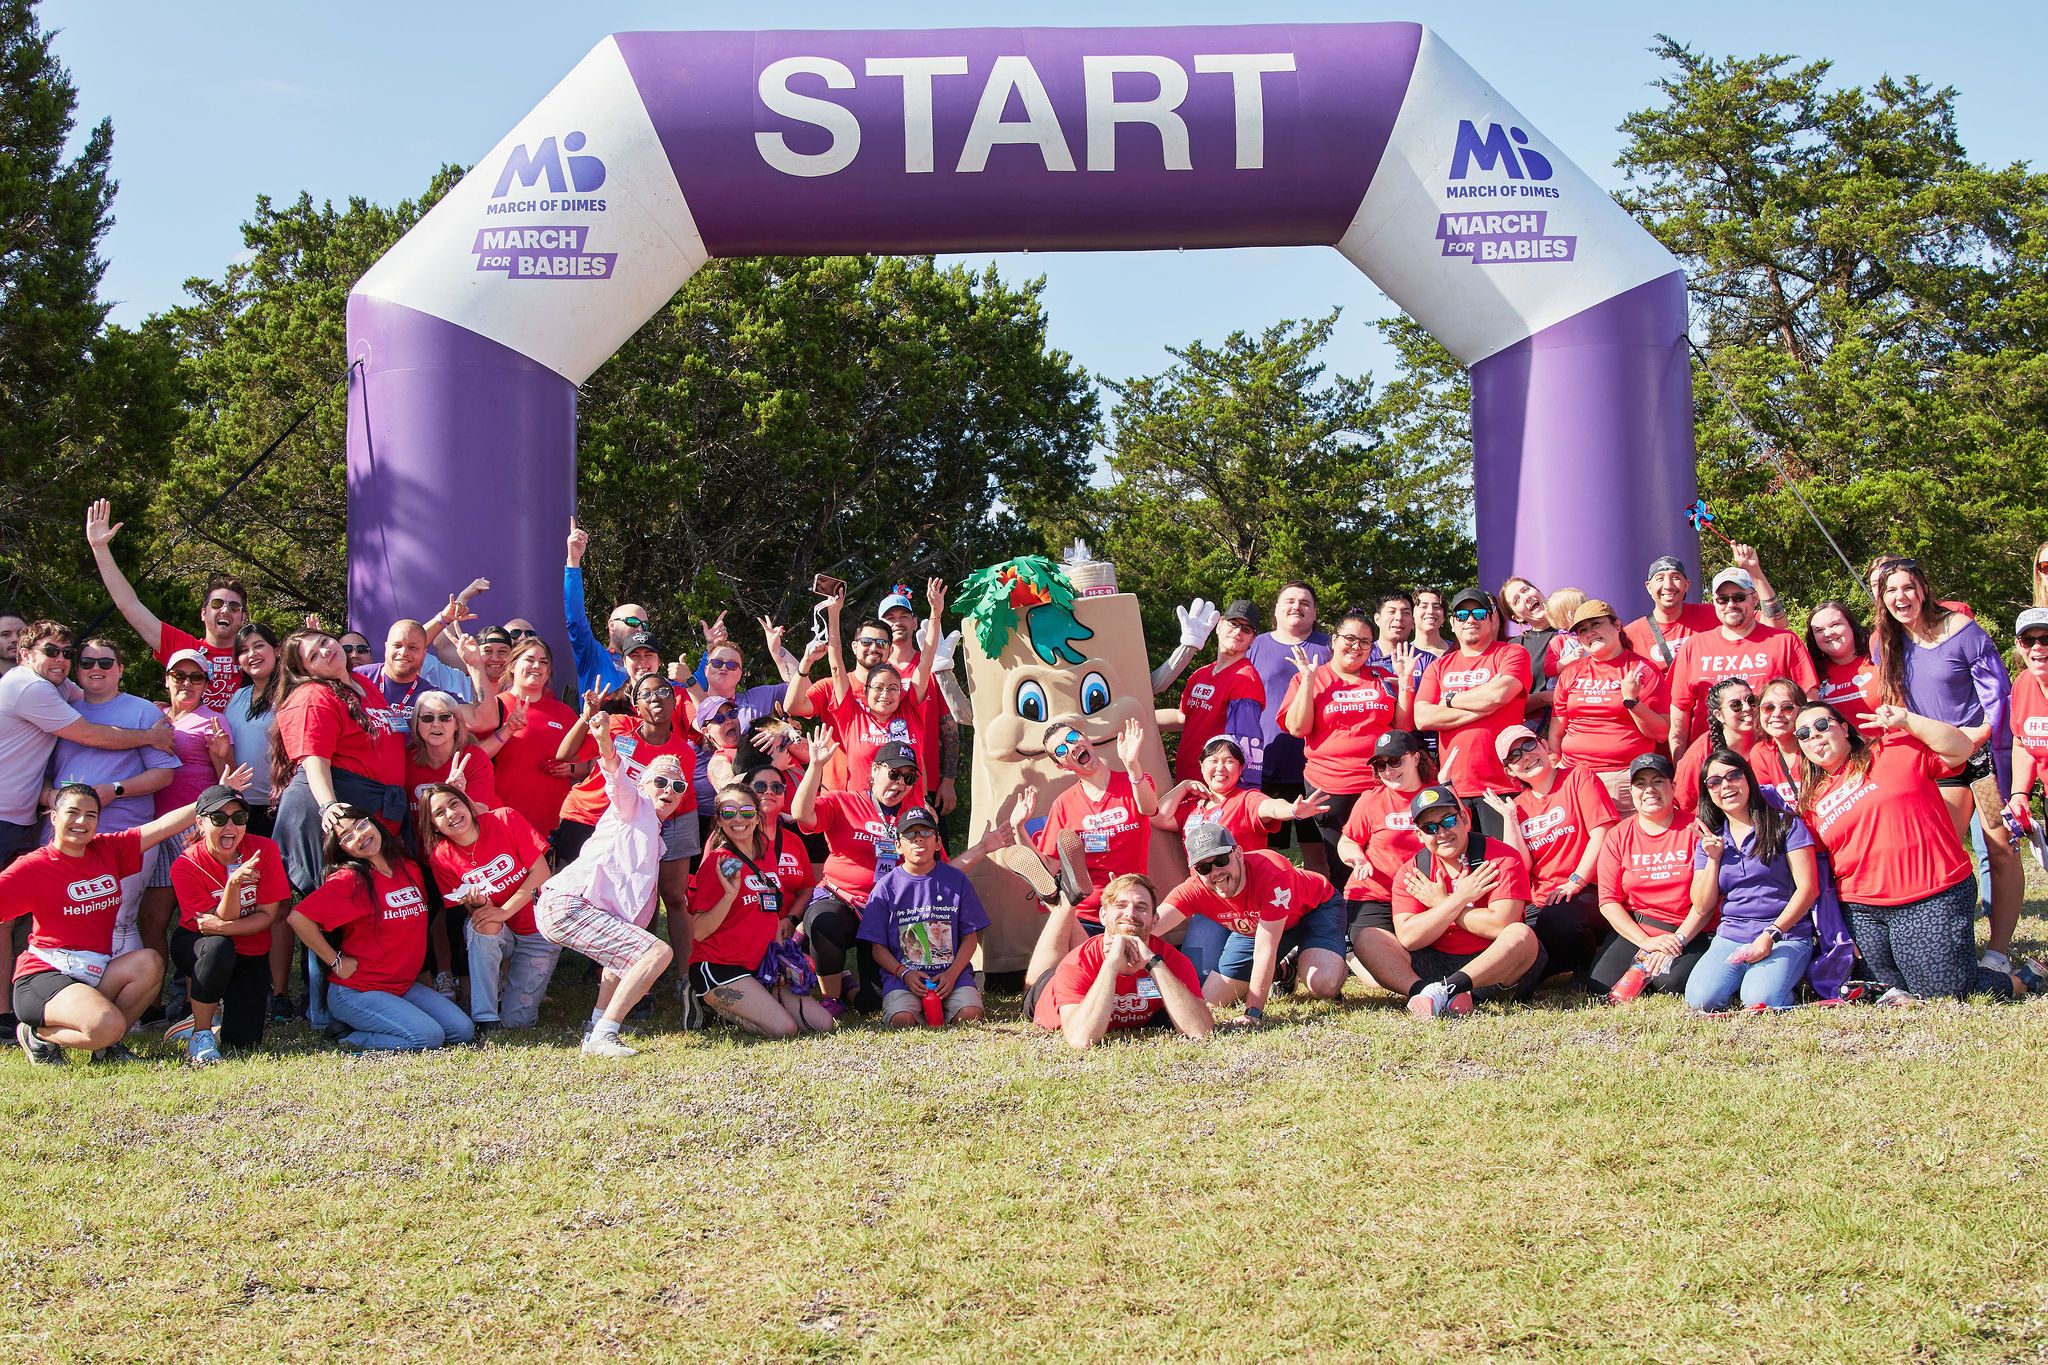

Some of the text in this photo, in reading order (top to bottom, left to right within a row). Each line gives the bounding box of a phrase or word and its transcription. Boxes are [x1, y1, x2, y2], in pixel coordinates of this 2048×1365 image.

[754, 52, 1297, 177] START
[1446, 186, 1559, 199] MARCH OF DIMES
[486, 199, 607, 215] MARCH OF DIMES
[1446, 214, 1538, 236] MARCH
[483, 230, 577, 250] MARCH
[1447, 239, 1568, 260] FOR BABIES
[483, 256, 607, 276] FOR BABIES
[1701, 653, 1768, 672] TEXAS
[1576, 678, 1622, 691] TEXAS
[1325, 701, 1389, 714] Helping Here
[1115, 823, 1140, 833] Here
[1631, 849, 1688, 866] TEXAS
[75, 879, 114, 896] H-E-B
[383, 905, 420, 920] Helping
